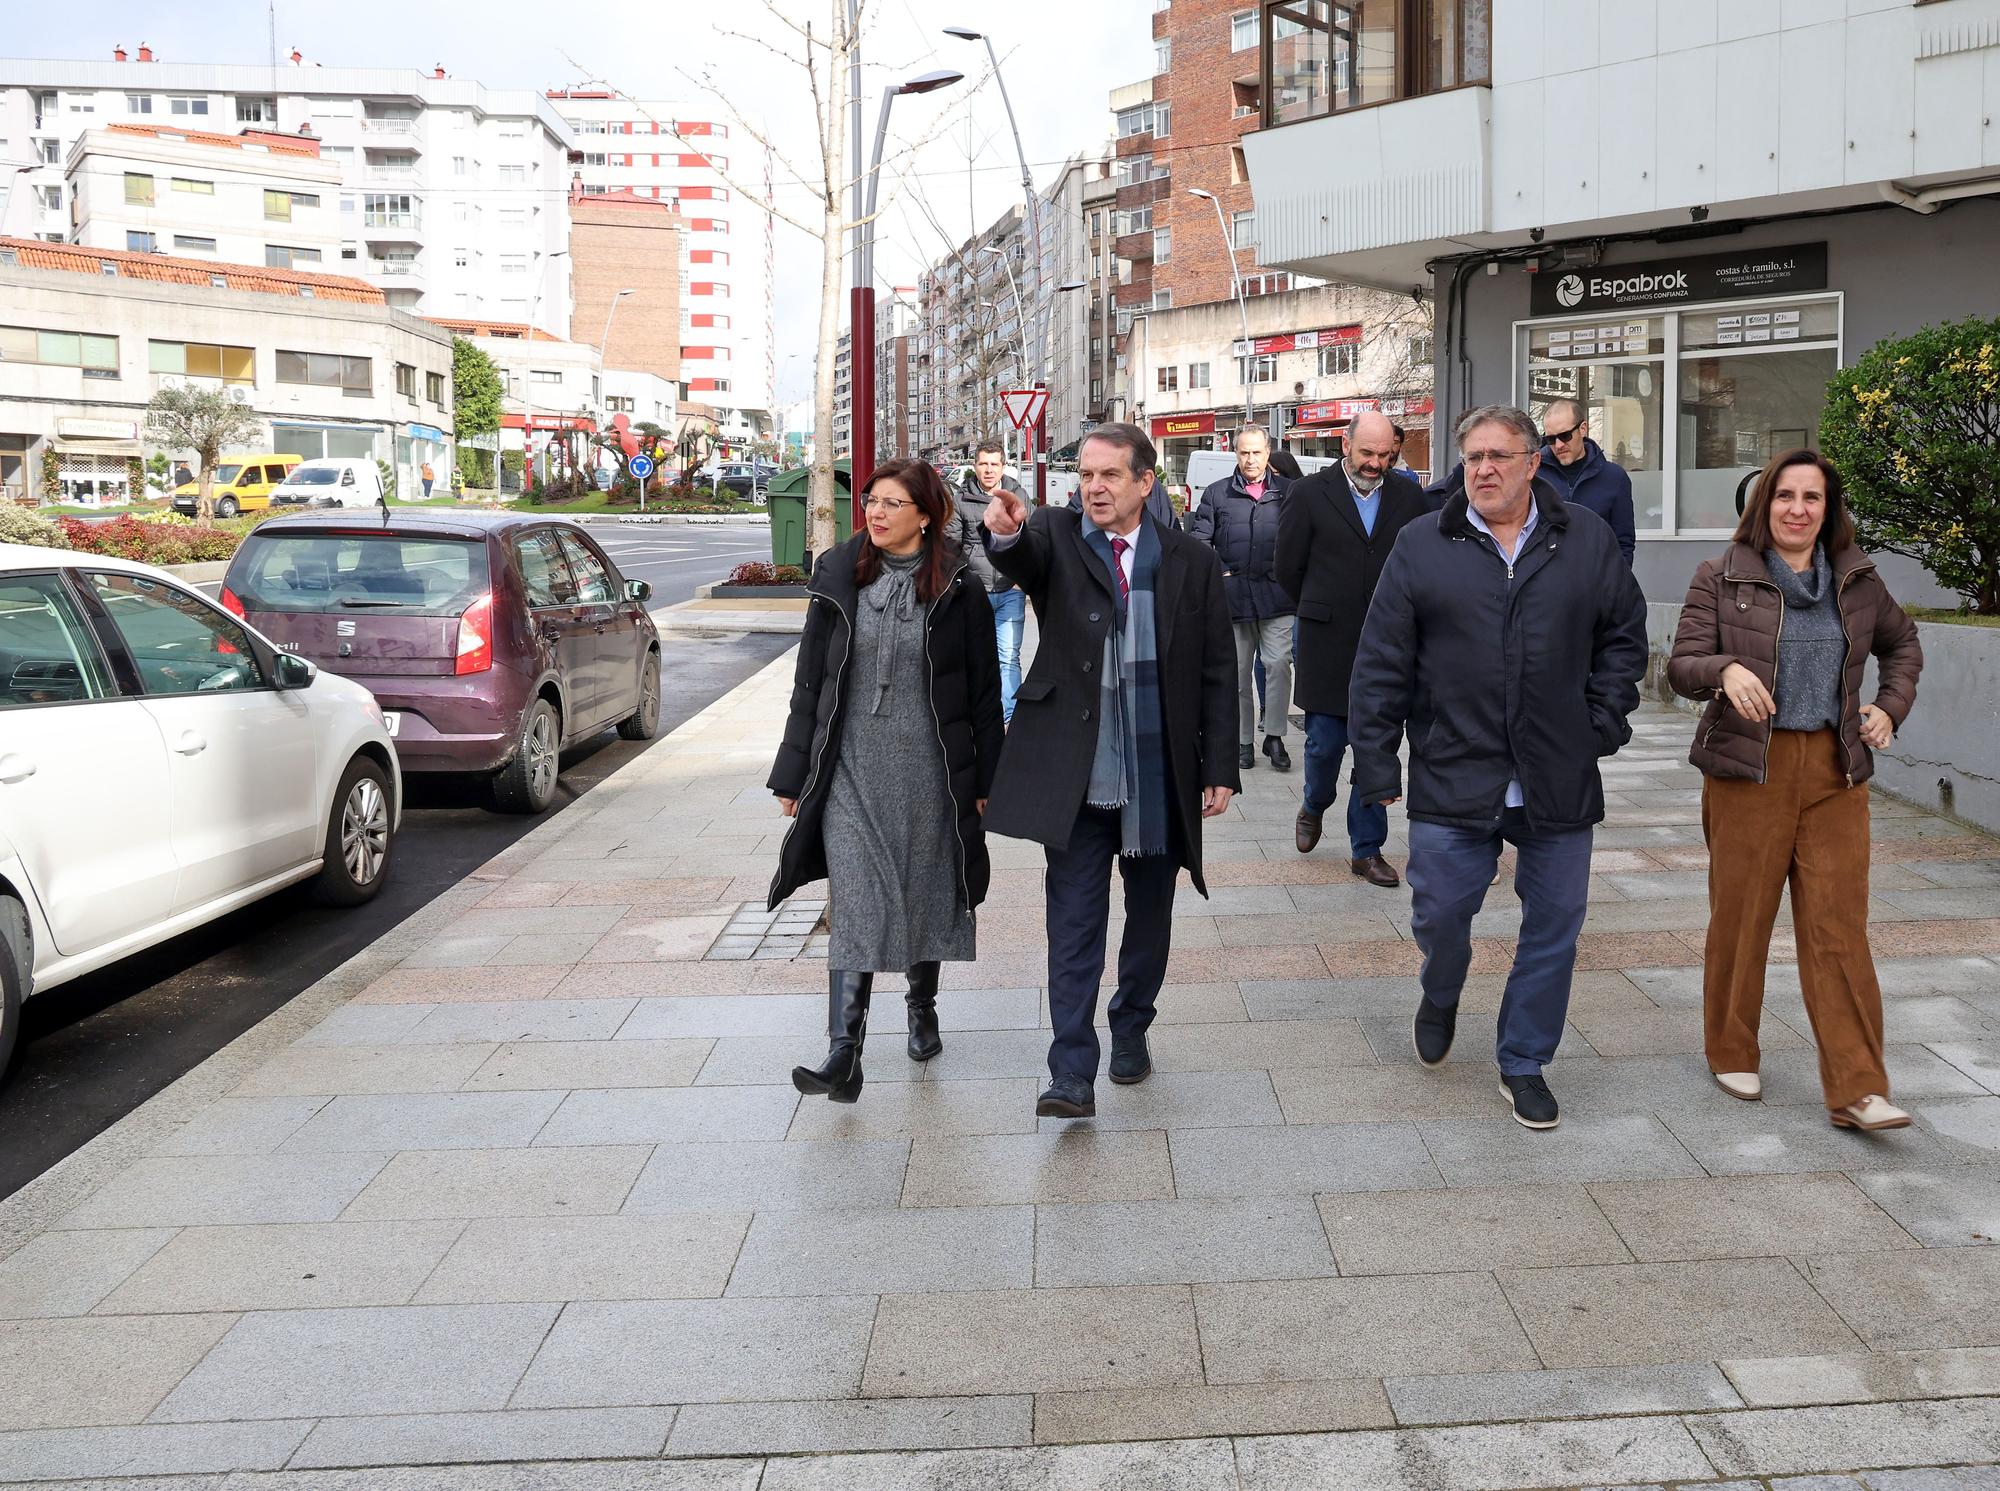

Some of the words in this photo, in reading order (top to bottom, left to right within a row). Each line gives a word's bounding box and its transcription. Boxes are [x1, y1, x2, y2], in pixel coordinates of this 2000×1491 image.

[1715, 266, 1740, 276] costas
[1742, 264, 1750, 273] &
[1752, 261, 1781, 273] ramilo,
[1783, 259, 1796, 269] s.l.
[1590, 270, 1688, 298] Espabrok
[1616, 293, 1653, 303] GENERAMOS
[1653, 290, 1689, 299] CONFIANZA
[1174, 422, 1200, 430] TABACOS
